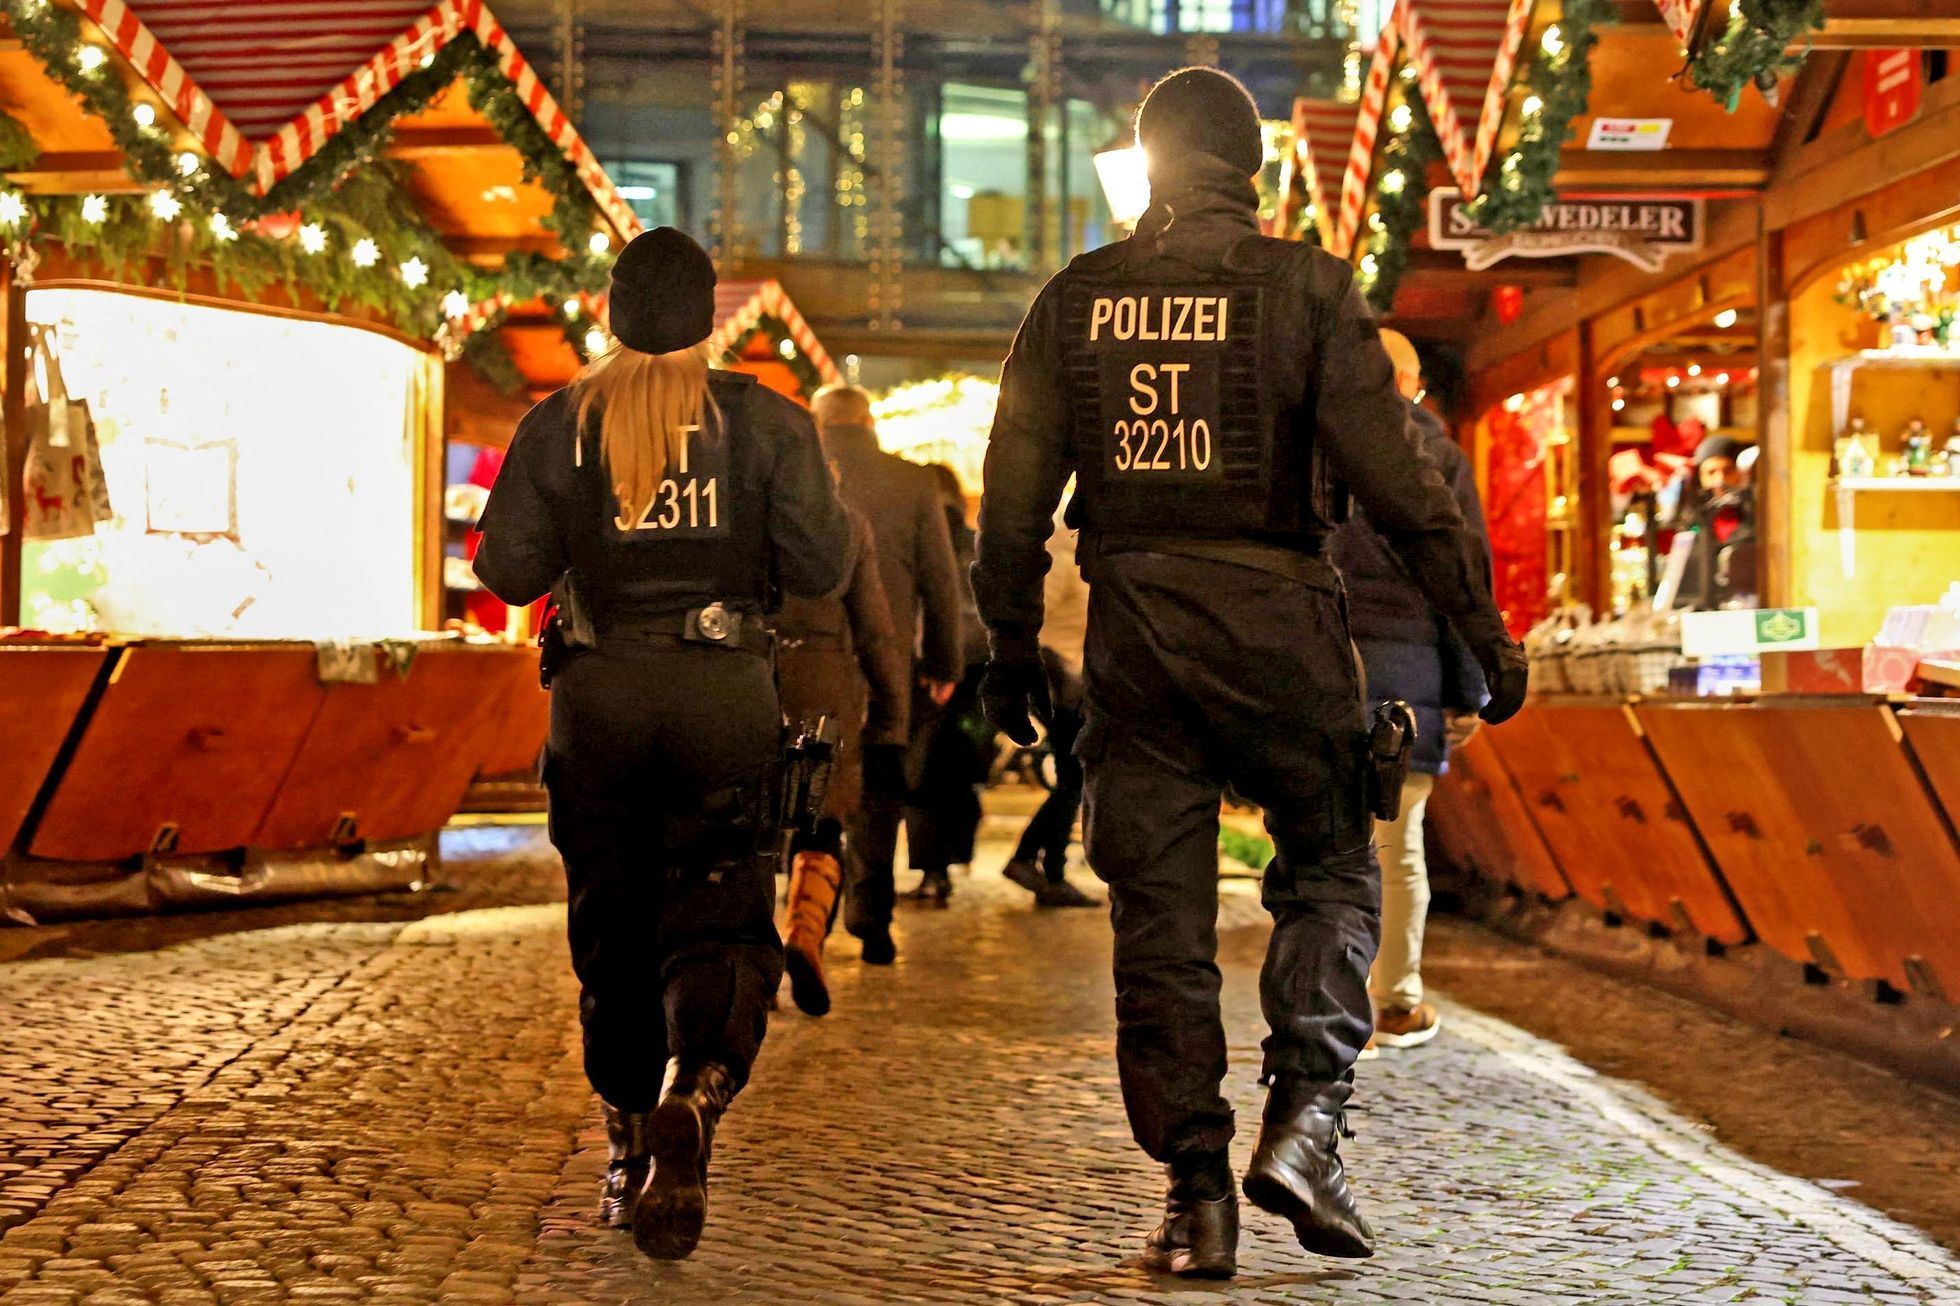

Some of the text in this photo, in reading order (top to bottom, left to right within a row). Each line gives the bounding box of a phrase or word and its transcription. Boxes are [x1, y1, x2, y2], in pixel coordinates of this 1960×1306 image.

[1450, 203, 1686, 238] SWEDELER
[1090, 296, 1228, 341] POLIZEI
[1129, 363, 1190, 416] ST
[1114, 418, 1211, 471] 32210
